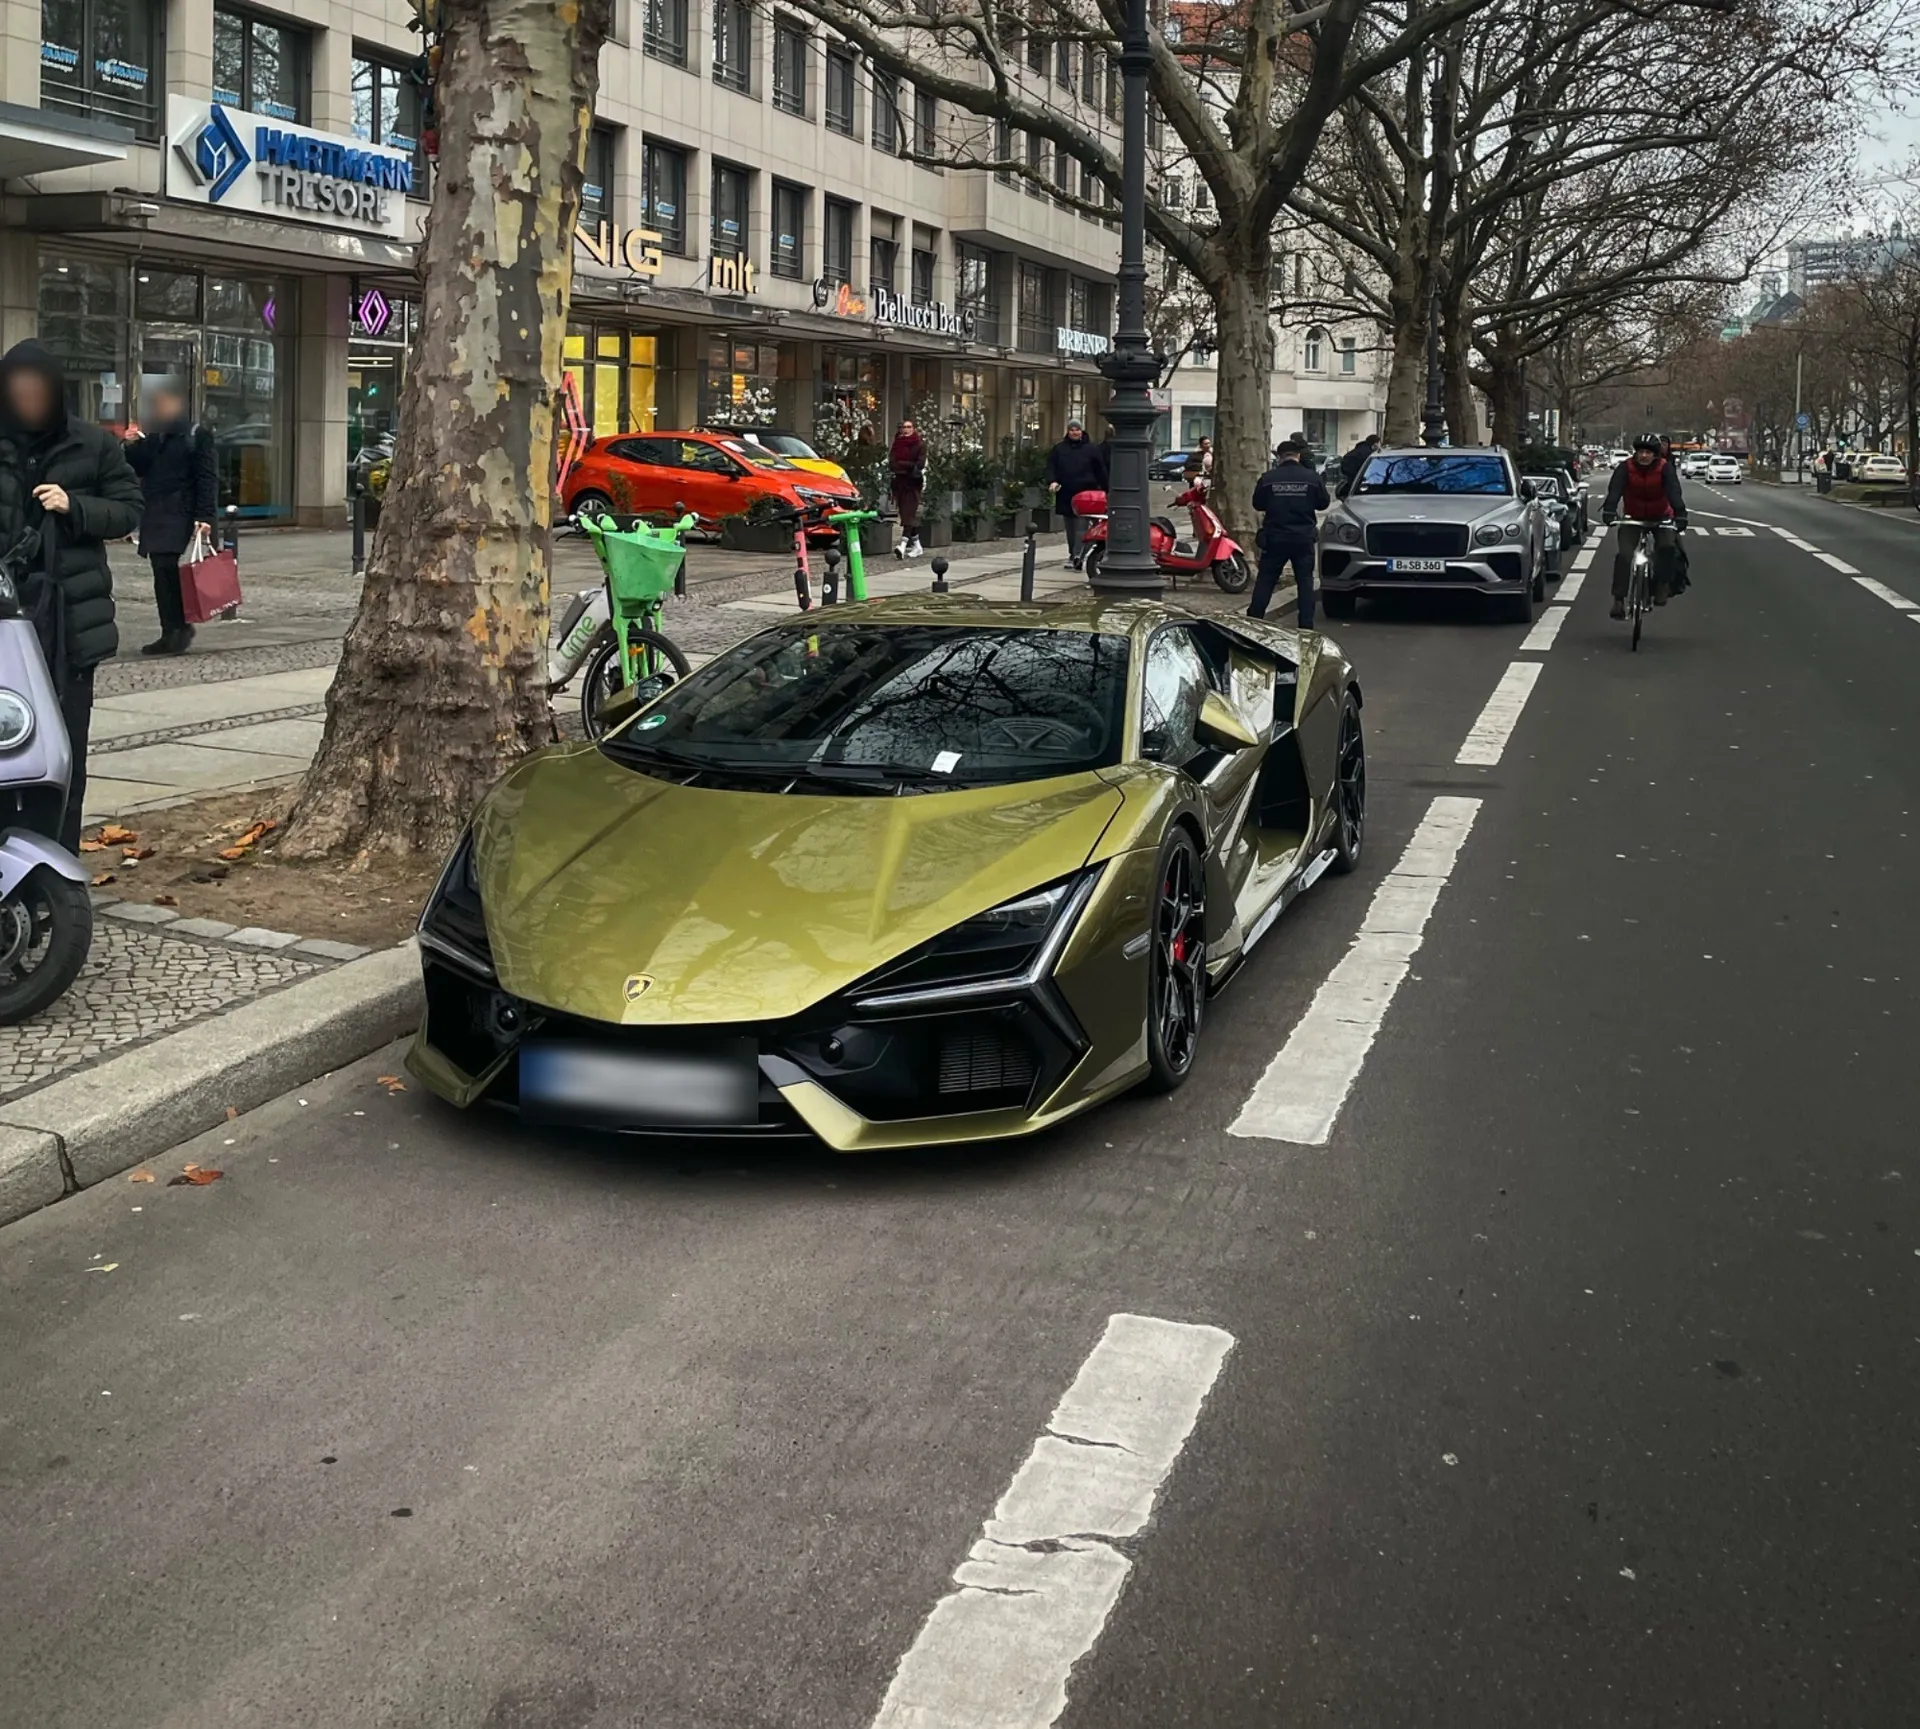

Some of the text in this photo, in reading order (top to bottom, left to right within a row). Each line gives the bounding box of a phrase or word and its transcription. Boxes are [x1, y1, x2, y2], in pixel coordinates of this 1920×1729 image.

[256, 127, 412, 192] HARTMANN
[256, 164, 391, 224] TRESORE
[877, 287, 935, 330] Bellucci
[939, 302, 962, 334] Bar
